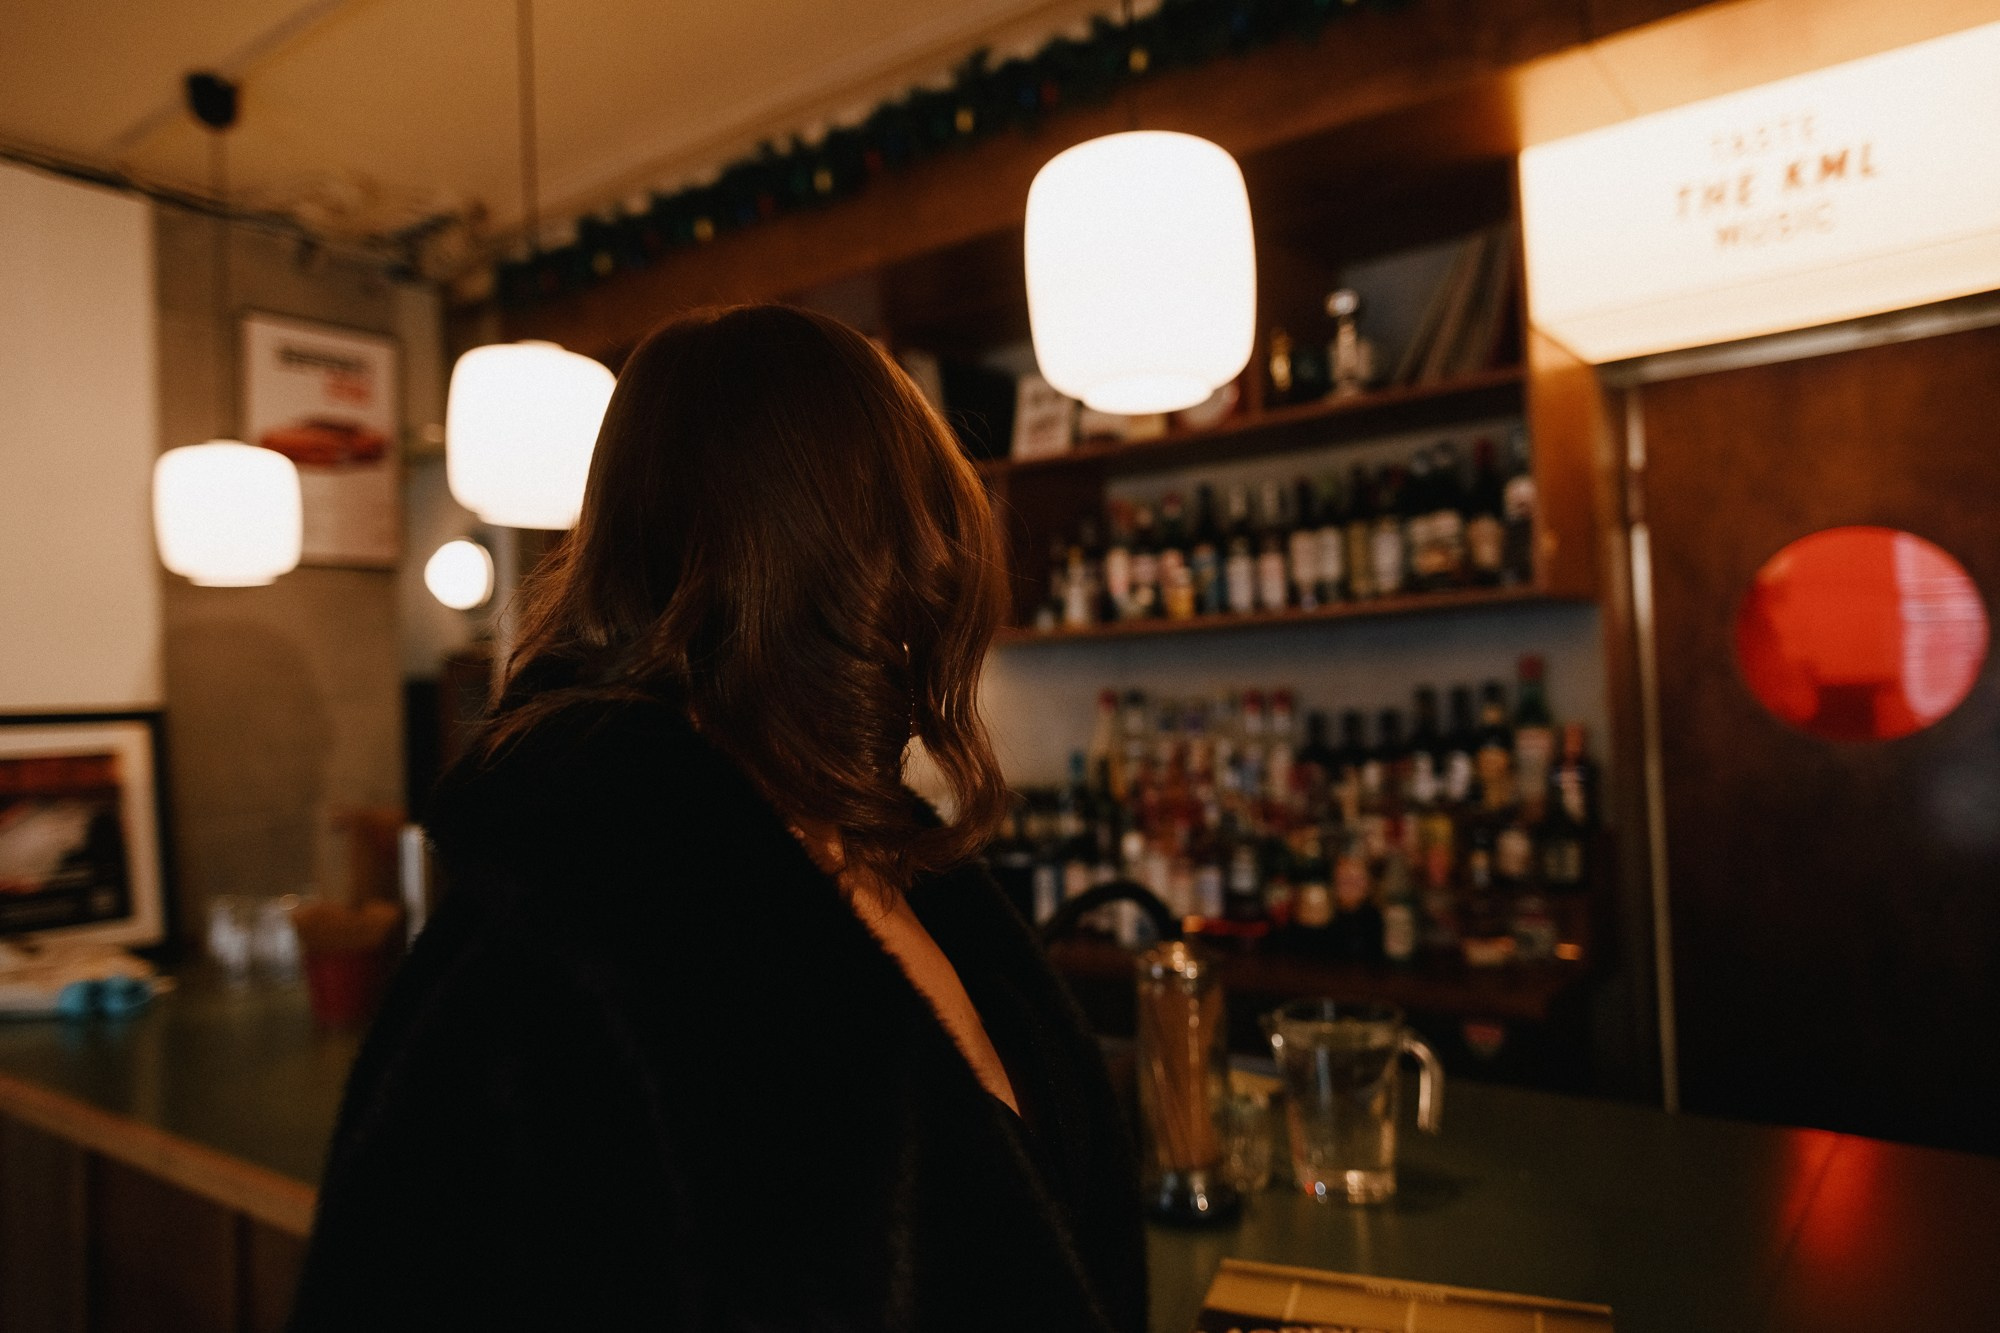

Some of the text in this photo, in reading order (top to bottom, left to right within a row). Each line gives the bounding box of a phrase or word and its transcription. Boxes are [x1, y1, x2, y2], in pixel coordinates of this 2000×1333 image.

[1711, 112, 1816, 160] TASTE
[1676, 142, 1881, 220] THE KML
[1715, 202, 1836, 249] MUSIC
